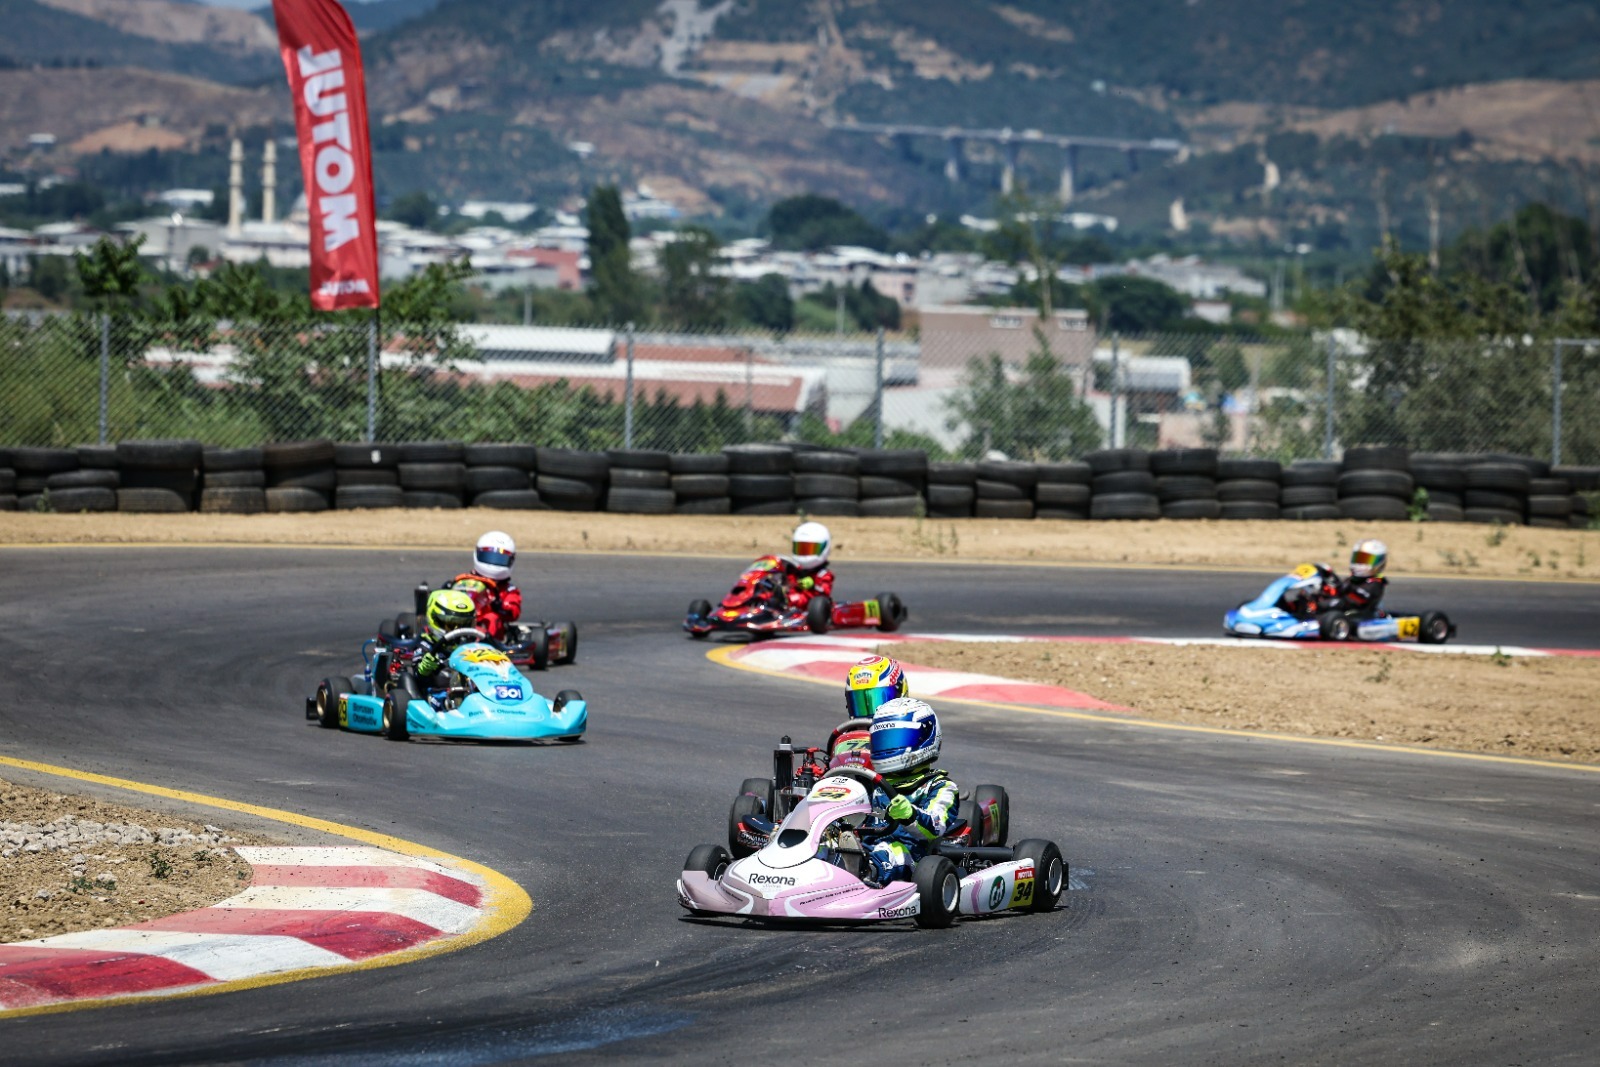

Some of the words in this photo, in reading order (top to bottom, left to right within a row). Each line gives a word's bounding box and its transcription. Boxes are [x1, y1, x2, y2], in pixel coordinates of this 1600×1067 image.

[748, 873, 796, 886] Rexona
[1013, 880, 1033, 901] 34
[878, 906, 917, 918] Rexona
